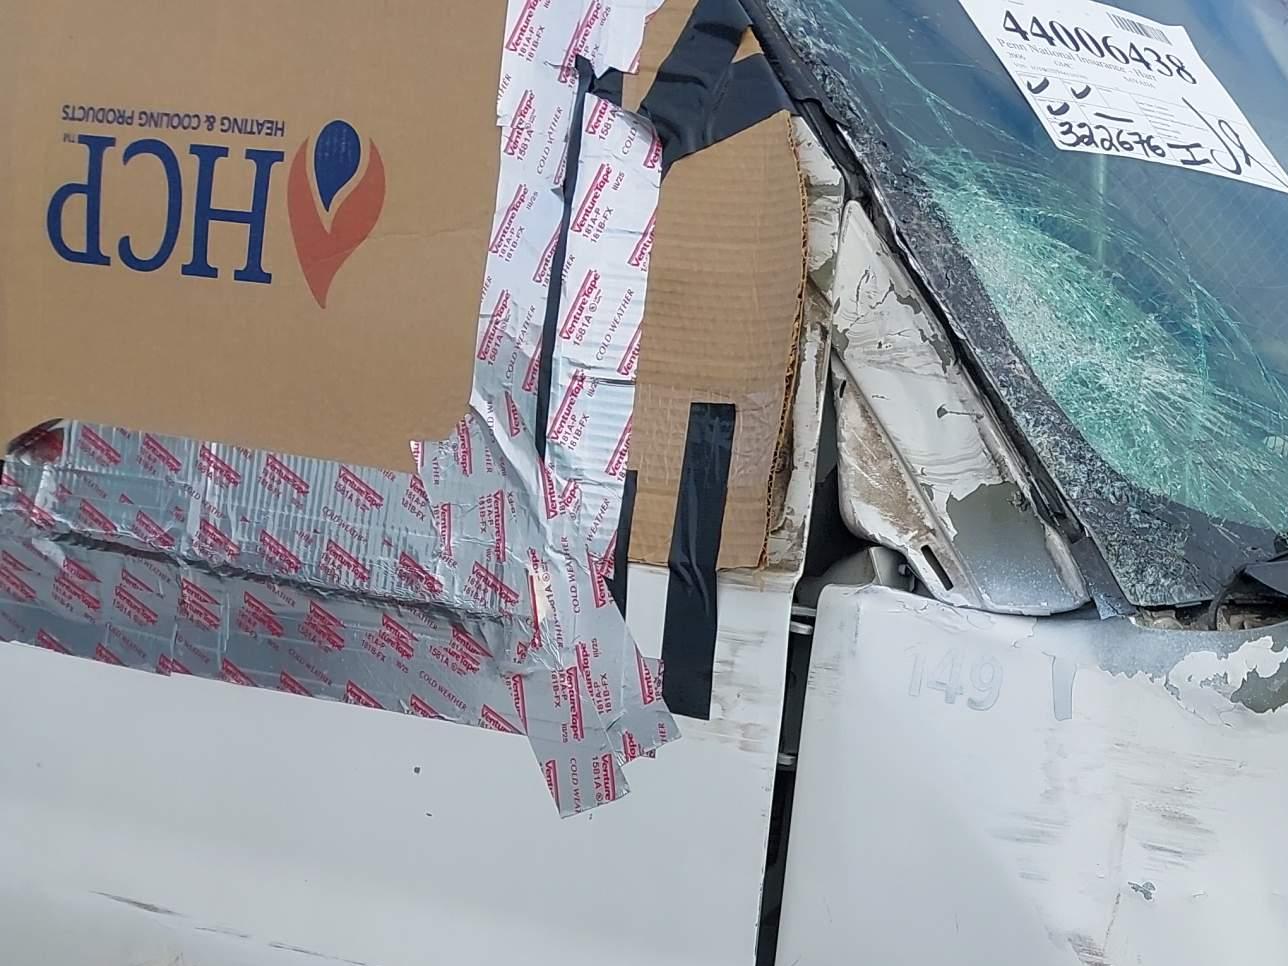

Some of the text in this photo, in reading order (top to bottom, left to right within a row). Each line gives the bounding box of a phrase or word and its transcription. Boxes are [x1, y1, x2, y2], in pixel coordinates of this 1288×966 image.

[1003, 10, 1198, 85] 44006438
[1027, 43, 1075, 61] National
[61, 104, 285, 137] HEATING & COOLING PRODUCTS
[47, 134, 285, 284] HCP
[573, 164, 613, 233] VentureTape
[492, 185, 528, 255] VentureTape
[583, 208, 600, 238] 181A-P
[591, 207, 614, 243] 181B-FX
[561, 269, 600, 341] VentureTape
[596, 331, 612, 361] COLD
[610, 288, 635, 333] WEATHER
[573, 315, 592, 347] 1581A
[551, 372, 587, 442] VentureTape
[560, 414, 577, 447] 181A-P
[339, 470, 383, 510] VentureTape
[569, 585, 580, 614] COLD
[428, 645, 450, 666] 1581A
[419, 670, 467, 711] COLD WEATHER
[566, 666, 582, 741] VentureTape
[570, 757, 579, 786] COLD
